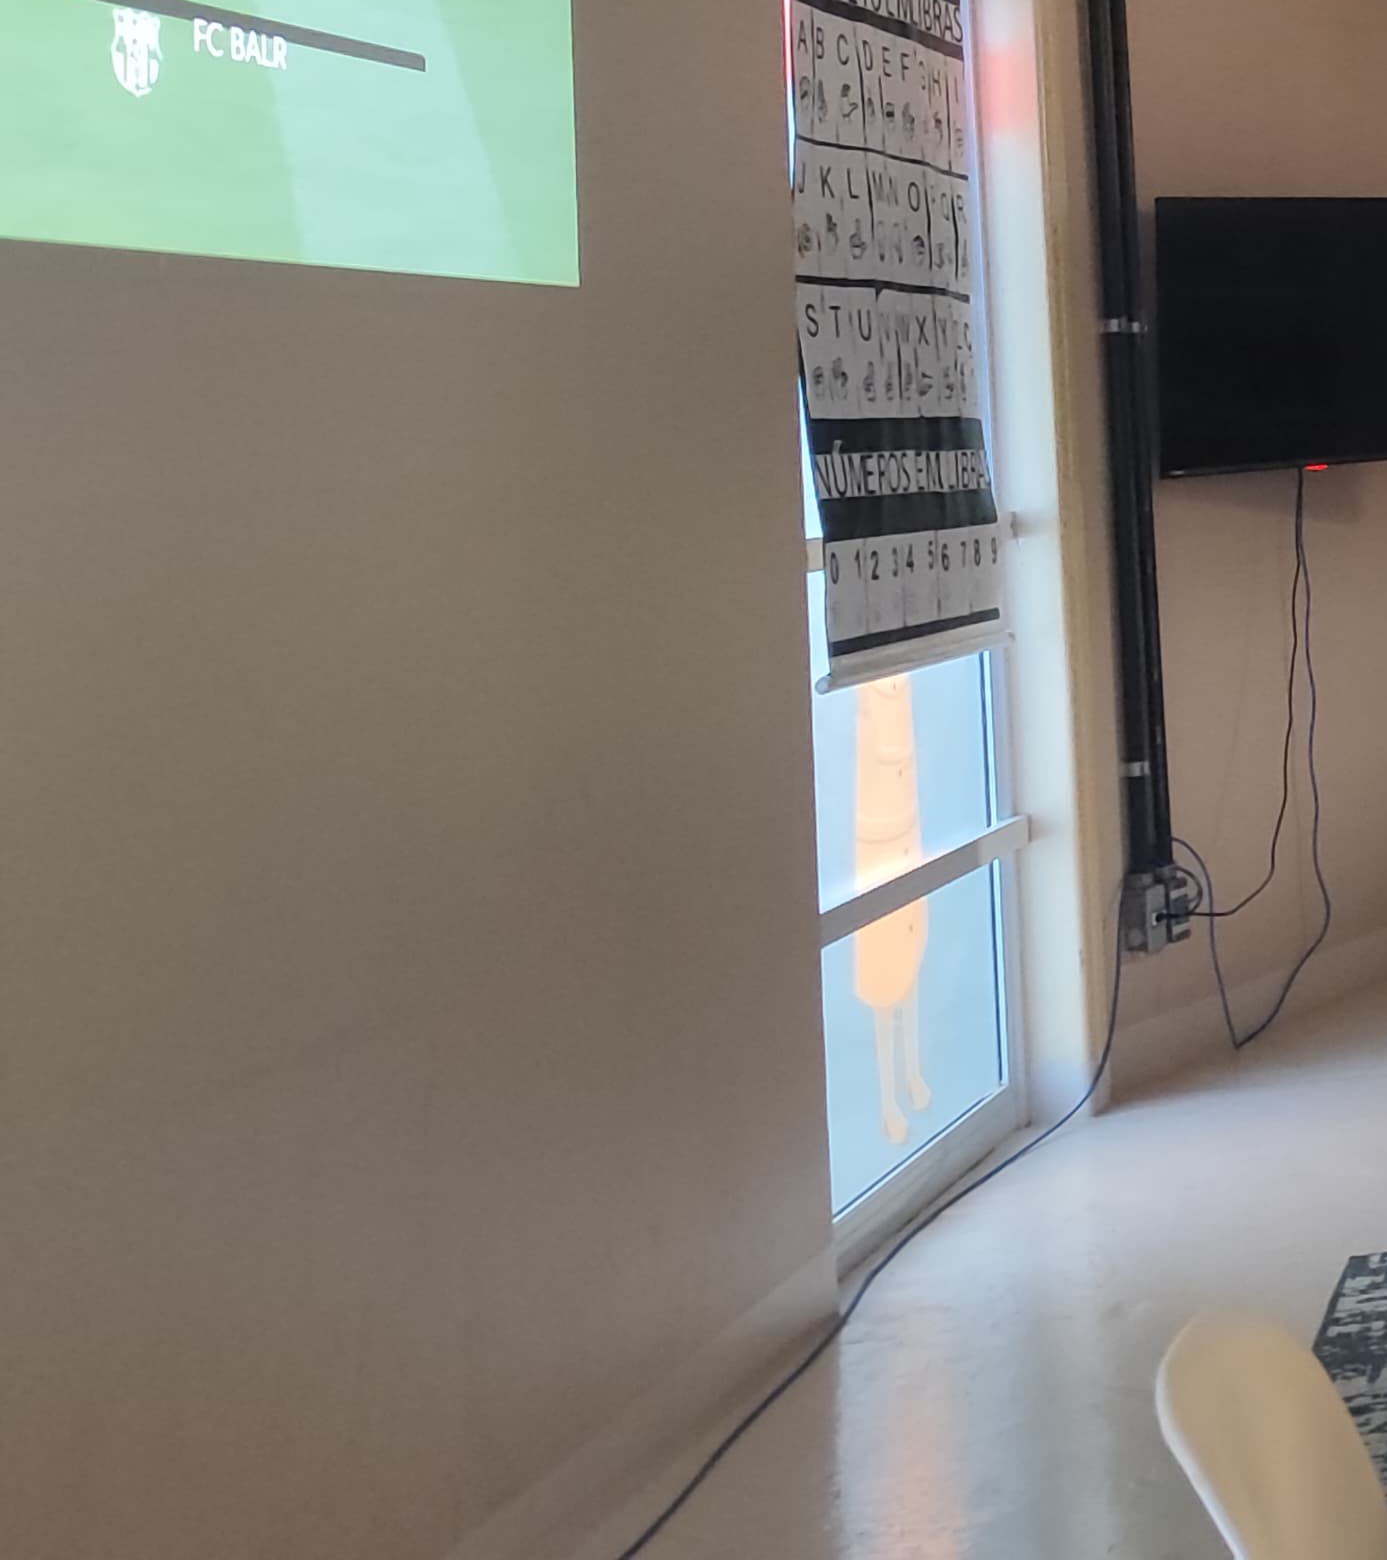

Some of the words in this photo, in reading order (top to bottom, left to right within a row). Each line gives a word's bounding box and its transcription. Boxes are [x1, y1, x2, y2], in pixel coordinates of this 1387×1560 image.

[193, 17, 225, 57] FC
[229, 25, 288, 71] BALR
[804, 303, 819, 338] S
[828, 305, 841, 339] T
[857, 308, 872, 342] U
[915, 315, 930, 347] X
[914, 451, 944, 491] EM
